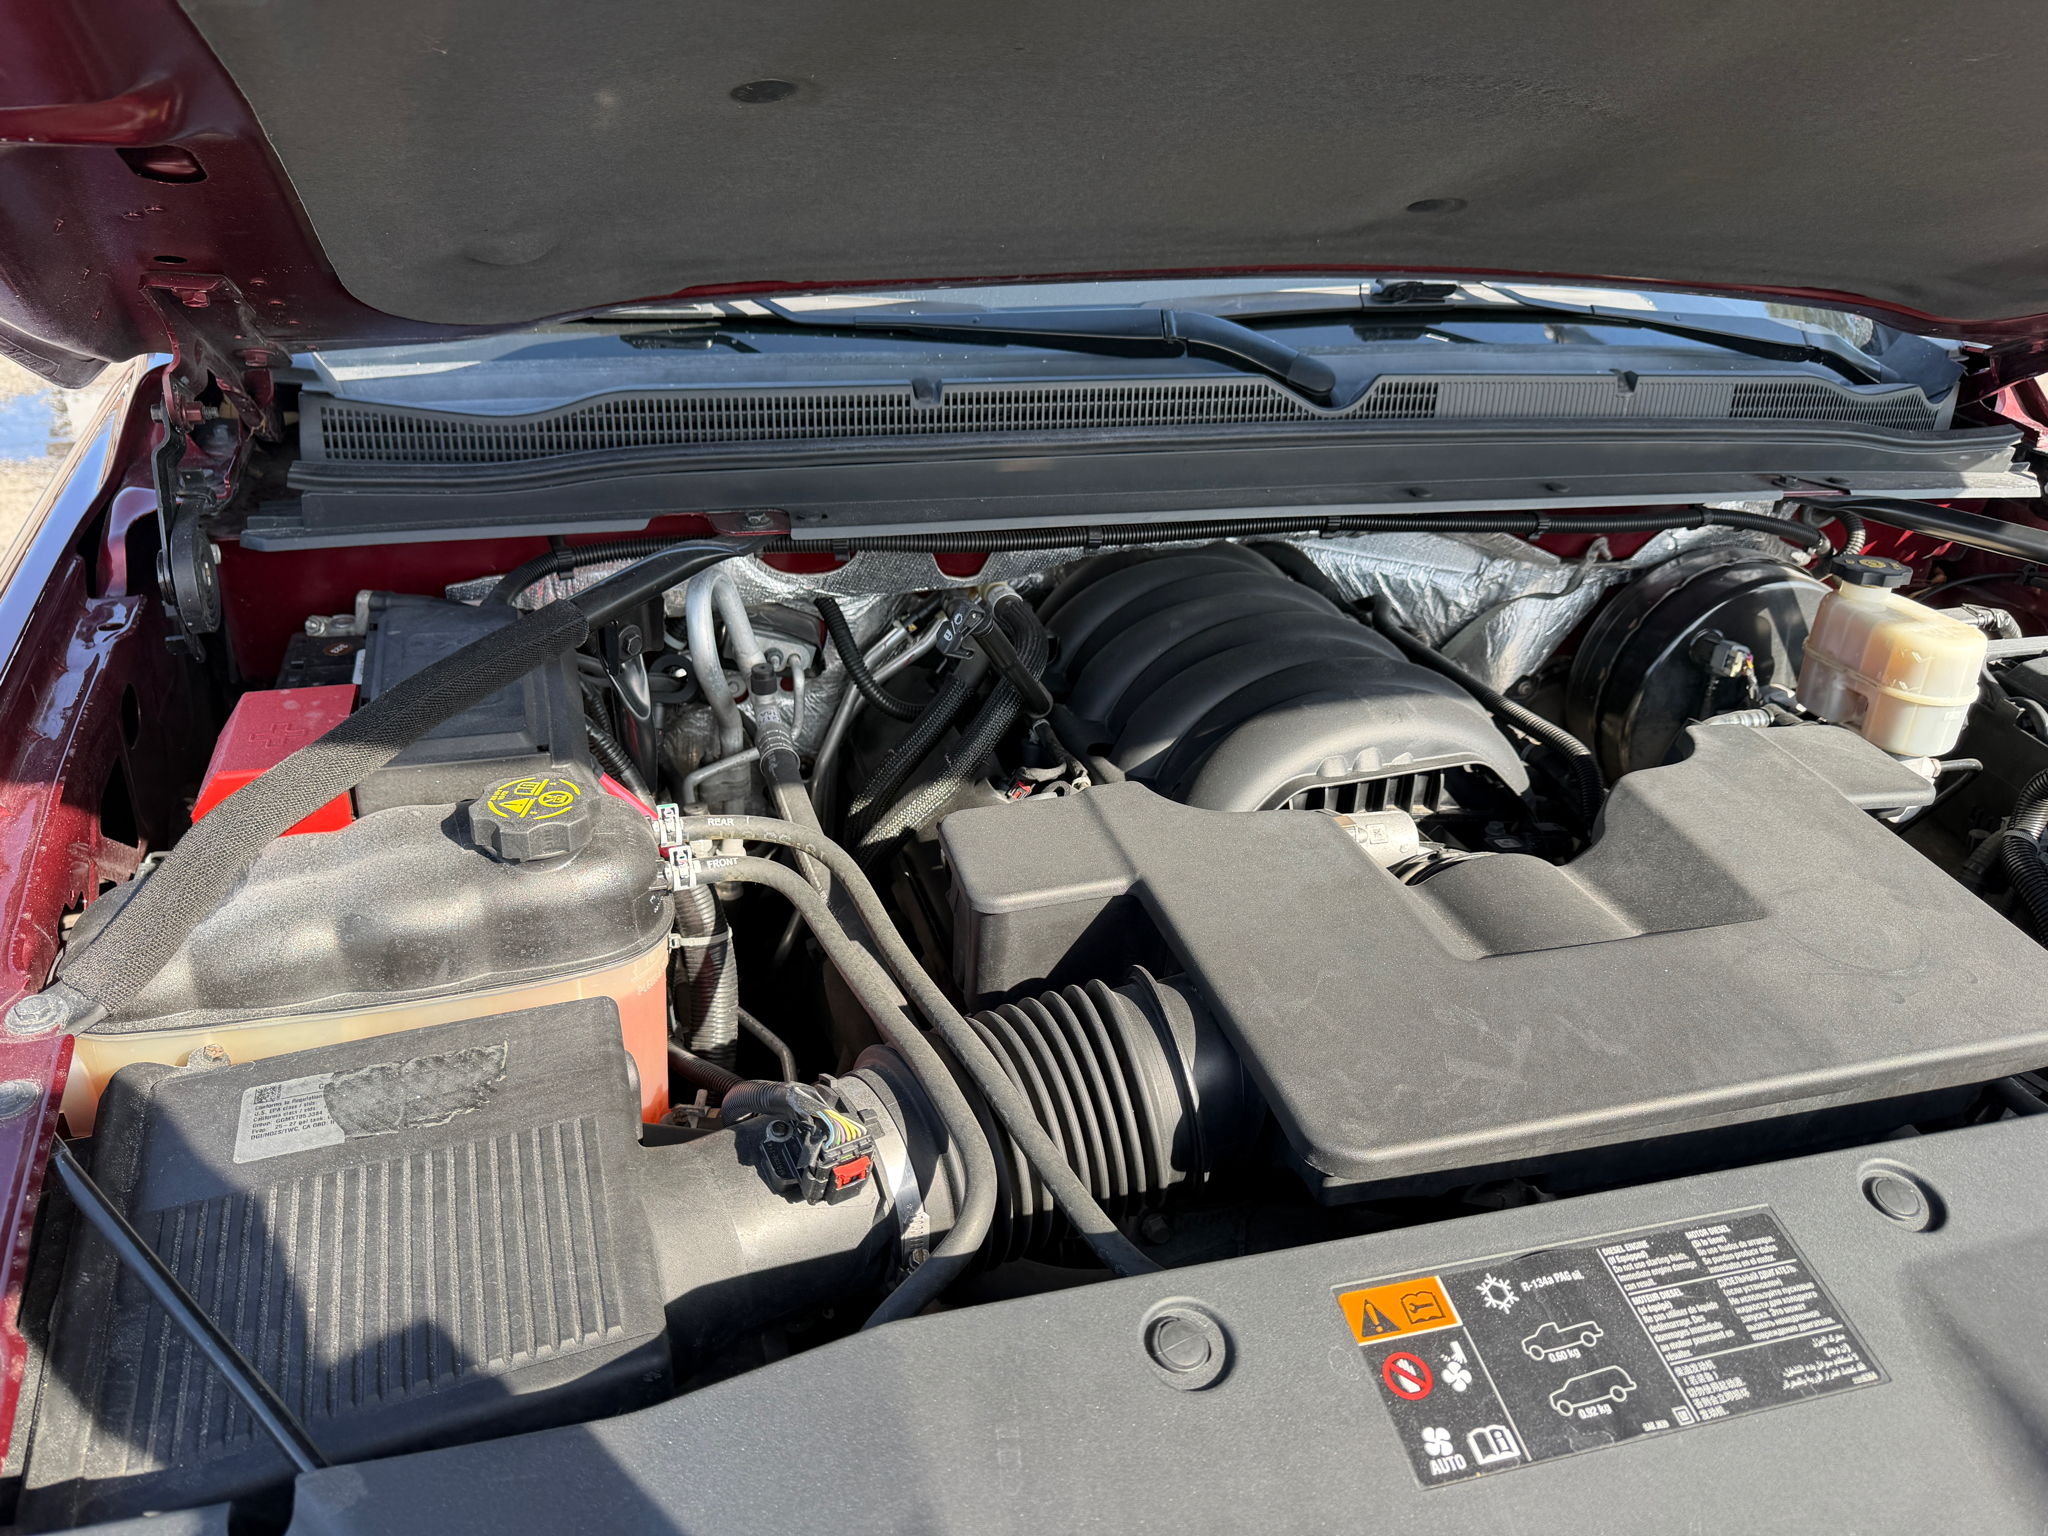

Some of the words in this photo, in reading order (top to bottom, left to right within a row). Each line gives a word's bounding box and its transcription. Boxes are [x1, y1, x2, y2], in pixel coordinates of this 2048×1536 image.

[707, 817, 735, 827] REAR
[706, 857, 739, 870] FRONT
[254, 1102, 282, 1110] Conforms
[253, 1113, 281, 1122] California
[1685, 1228, 1709, 1239] MOTOR
[1707, 1225, 1730, 1235] DIESEL
[1707, 1235, 1727, 1244] tiene)
[1601, 1245, 1625, 1256] DIESEL
[1624, 1240, 1649, 1251] ENGINE
[1696, 1248, 1707, 1256] No
[1706, 1246, 1718, 1254] use
[1717, 1243, 1739, 1252] fluidos
[1738, 1240, 1747, 1248] de
[1747, 1236, 1775, 1246] arranque.
[1615, 1250, 1648, 1263] Equipped)
[1701, 1257, 1712, 1265] Se
[1711, 1253, 1735, 1264] pueden
[1734, 1248, 1759, 1259] producir
[1741, 1259, 1750, 1267] en
[1749, 1257, 1757, 1265] el
[1756, 1254, 1776, 1263] motor.
[1612, 1265, 1623, 1273] Do
[1622, 1262, 1634, 1271] not
[1633, 1261, 1646, 1269] use
[1645, 1256, 1670, 1266] starting
[1617, 1270, 1651, 1282] Immediate
[1651, 1266, 1672, 1275] engine
[1672, 1261, 1697, 1271] damage
[1520, 1276, 1554, 1291] R-134a
[1553, 1270, 1572, 1282] PAG
[1571, 1269, 1584, 1280] oil.
[1623, 1282, 1637, 1291] can
[1636, 1278, 1657, 1288] result.
[1717, 1272, 1759, 1288] ДИЗЕЛЬНЫЙ
[1722, 1287, 1743, 1297] (если
[1742, 1278, 1783, 1293] установлен)
[1631, 1292, 1660, 1305] MOTEUR
[1659, 1288, 1683, 1299] DIESEL
[1728, 1297, 1740, 1305] Не
[1768, 1298, 1782, 1308] для
[1782, 1291, 1817, 1303] холодного
[1642, 1315, 1654, 1323] Ne
[1653, 1313, 1666, 1322] pas
[1665, 1308, 1687, 1319] utiliser
[1687, 1305, 1697, 1314] de
[1695, 1301, 1719, 1312] liquide
[1768, 1308, 1784, 1316] Это
[1783, 1303, 1806, 1313] может
[1690, 1315, 1706, 1324] Des
[1654, 1329, 1690, 1342] dommages
[1660, 1344, 1670, 1352] au
[1669, 1338, 1692, 1349] moteur
[1692, 1330, 1726, 1345] pourraient
[1724, 1329, 1735, 1338] en
[1548, 1350, 1568, 1362] 0.60
[1566, 1348, 1581, 1358] kg
[1578, 1406, 1598, 1419] 0.92
[1596, 1403, 1612, 1414] kg
[1430, 1454, 1466, 1475] AUTO
